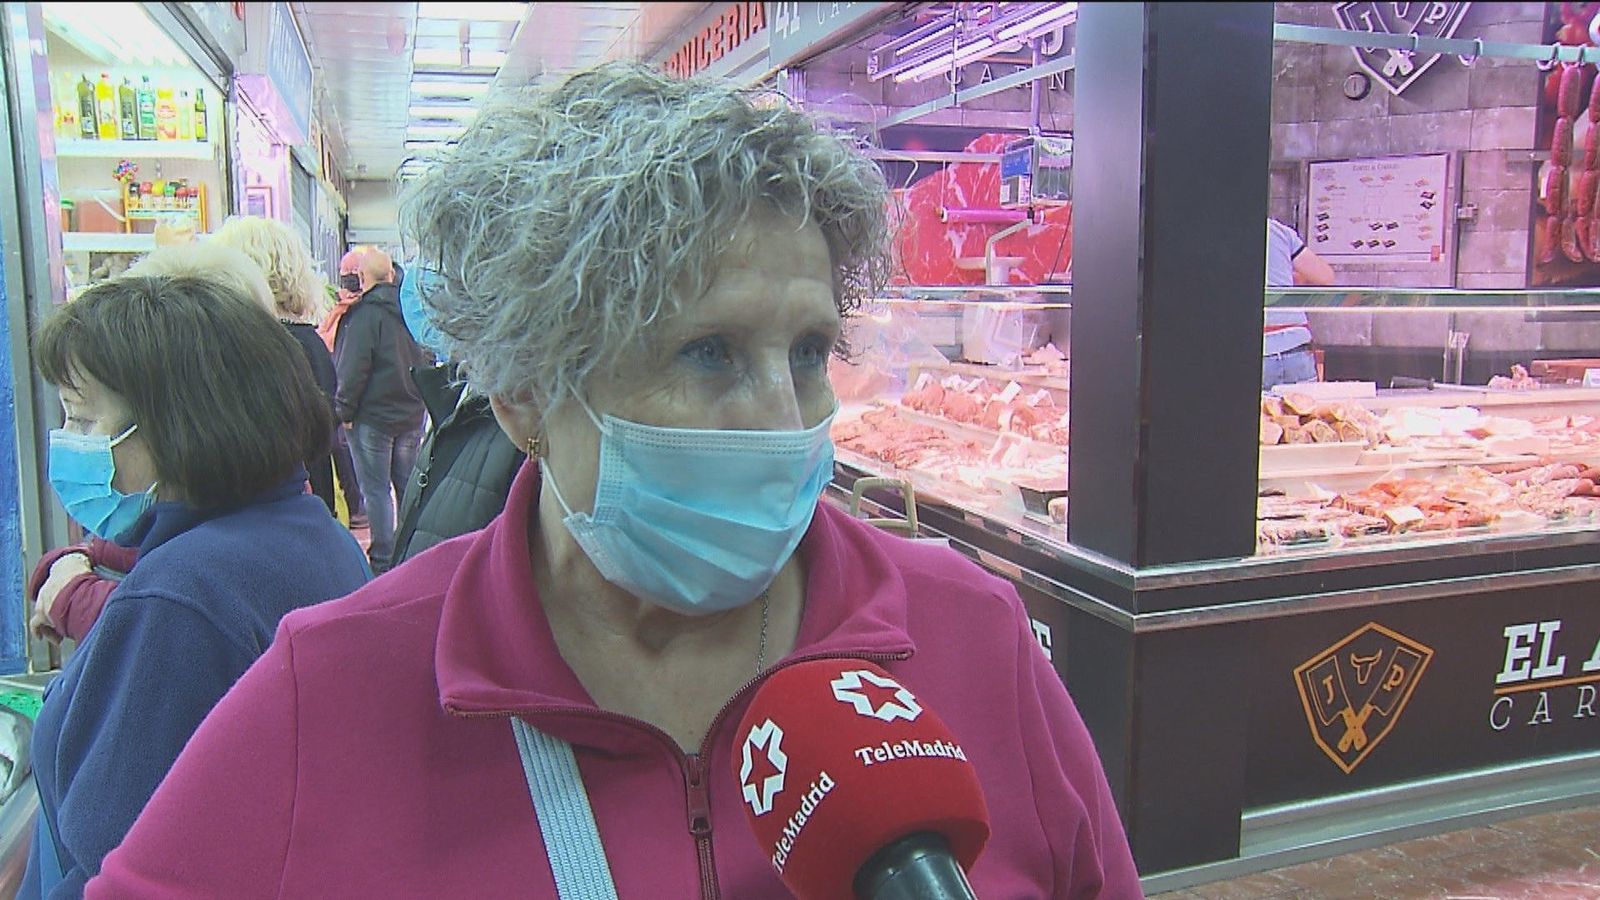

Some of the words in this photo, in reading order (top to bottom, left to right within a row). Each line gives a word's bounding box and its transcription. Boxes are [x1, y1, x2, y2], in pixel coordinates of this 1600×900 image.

[661, 3, 767, 79] RNICERIA
[1495, 620, 1566, 684] EL
[1322, 674, 1335, 705] J
[1382, 663, 1406, 692] P
[1489, 685, 1597, 731] CAR
[854, 739, 968, 767] TeleMadrid
[771, 770, 836, 874] TeleMadrid
